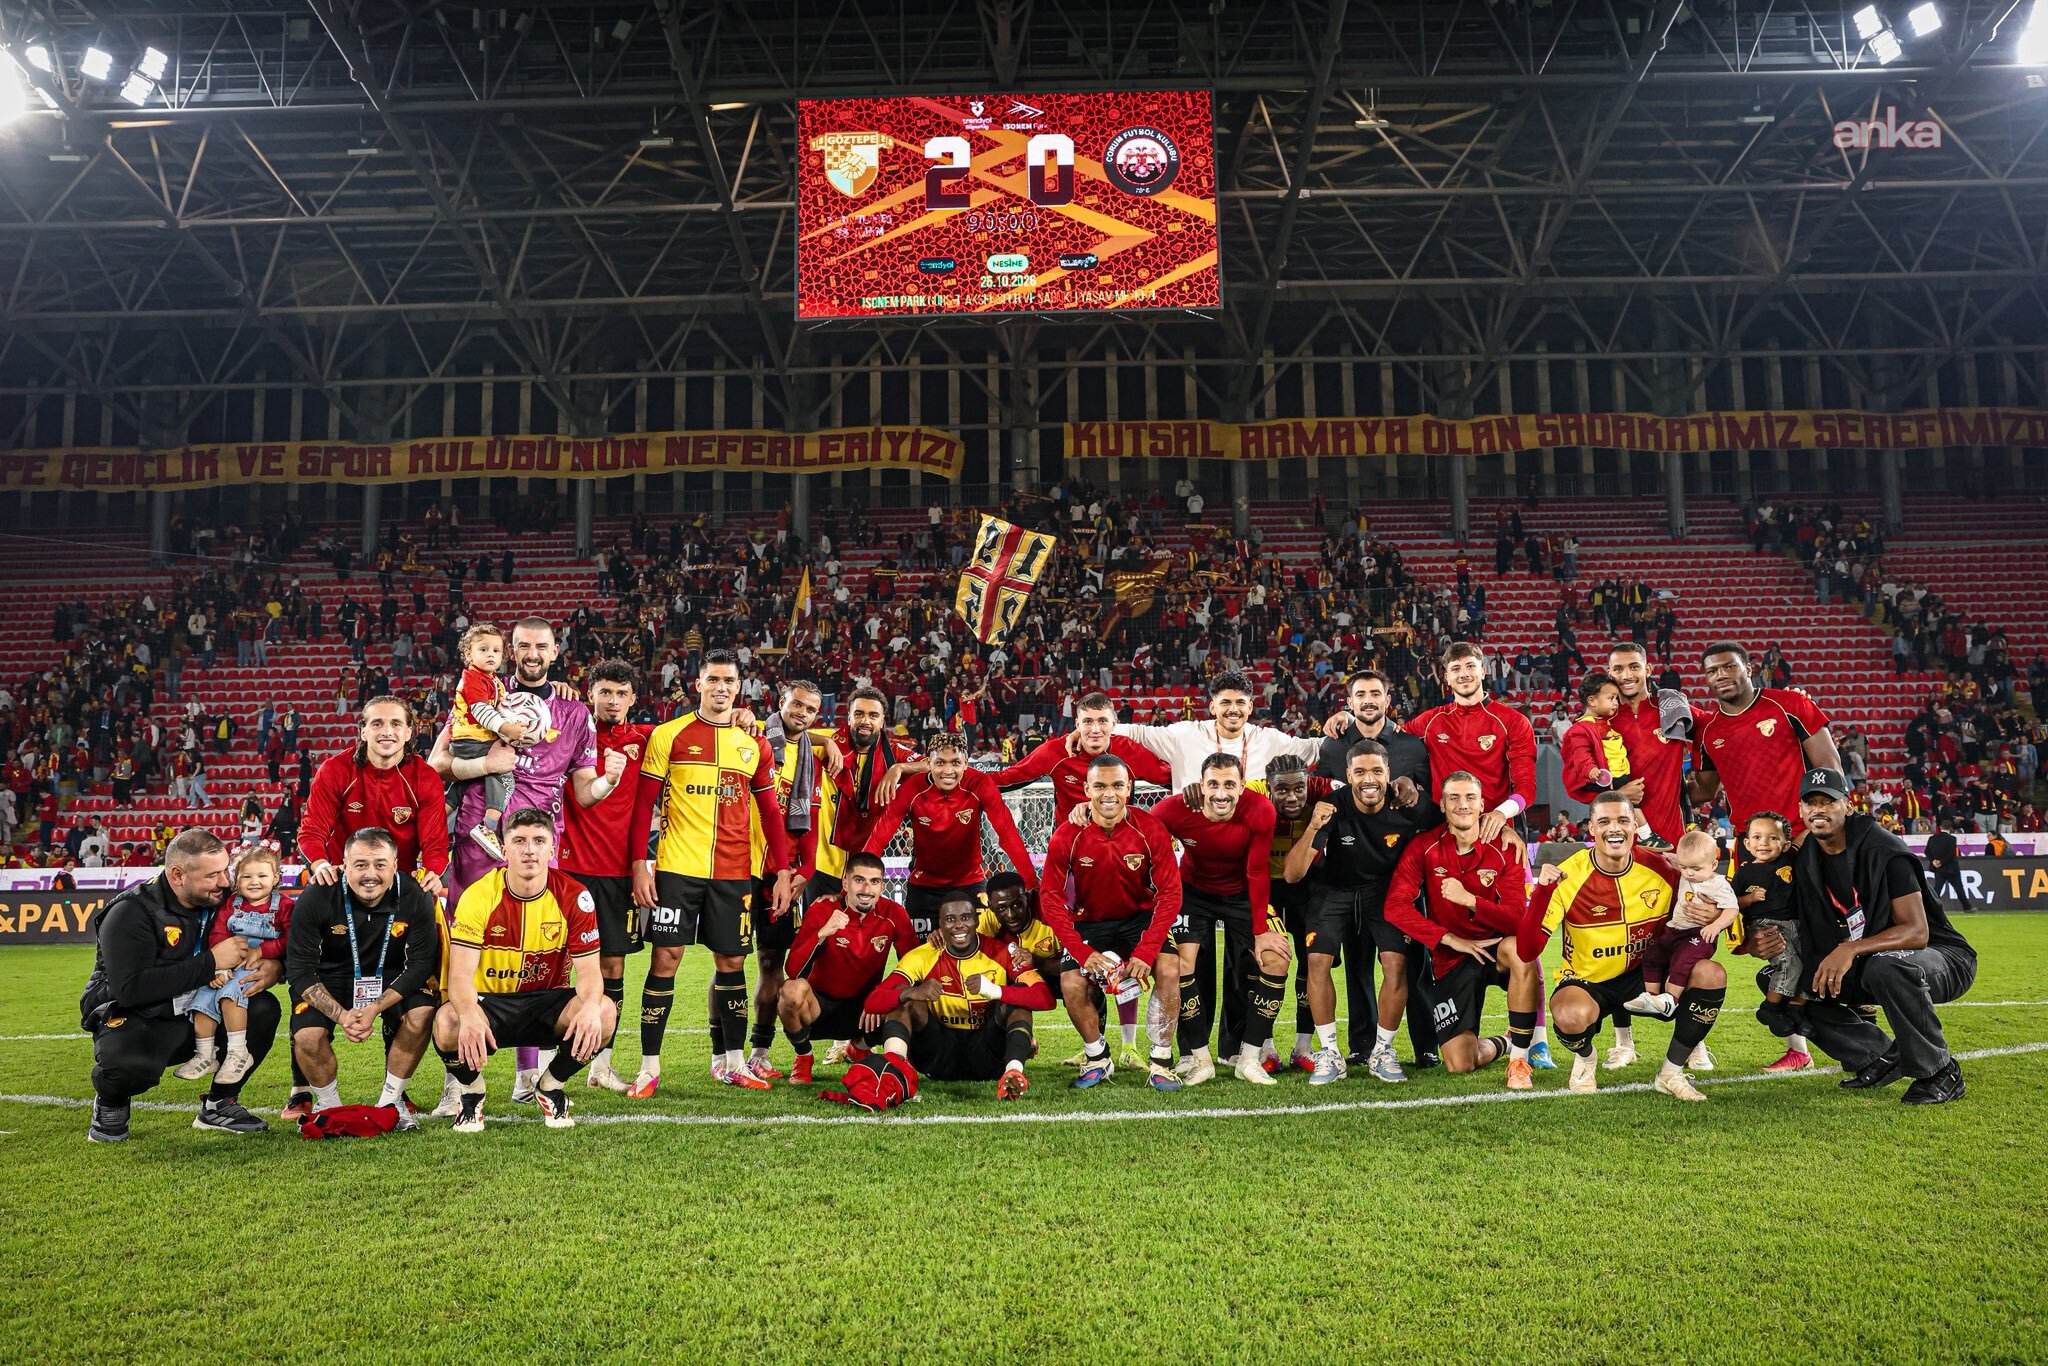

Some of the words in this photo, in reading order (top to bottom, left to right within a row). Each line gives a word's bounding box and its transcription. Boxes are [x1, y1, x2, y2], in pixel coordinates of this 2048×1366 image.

[827, 134, 877, 145] GÖZTEPE
[1122, 128, 1155, 139] FUTBOL
[924, 136, 971, 210] 2
[1026, 134, 1075, 208] 0
[862, 295, 899, 309] ISONEM
[900, 293, 924, 307] PARK
[1071, 421, 1225, 457] KUTSAL
[1239, 417, 1409, 458] ARMAYA
[1423, 415, 1525, 455] OLAN
[1535, 407, 1800, 451] SADAKATİMİZ
[60, 448, 220, 488] GENÇLİK
[235, 445, 286, 477] VE
[297, 445, 392, 477] SPOR
[408, 435, 650, 474] KULÜBÜ'NÜN
[663, 427, 956, 469] NEFERLERİYİZ!
[686, 784, 735, 797] euroil
[1593, 938, 1647, 959] euroil
